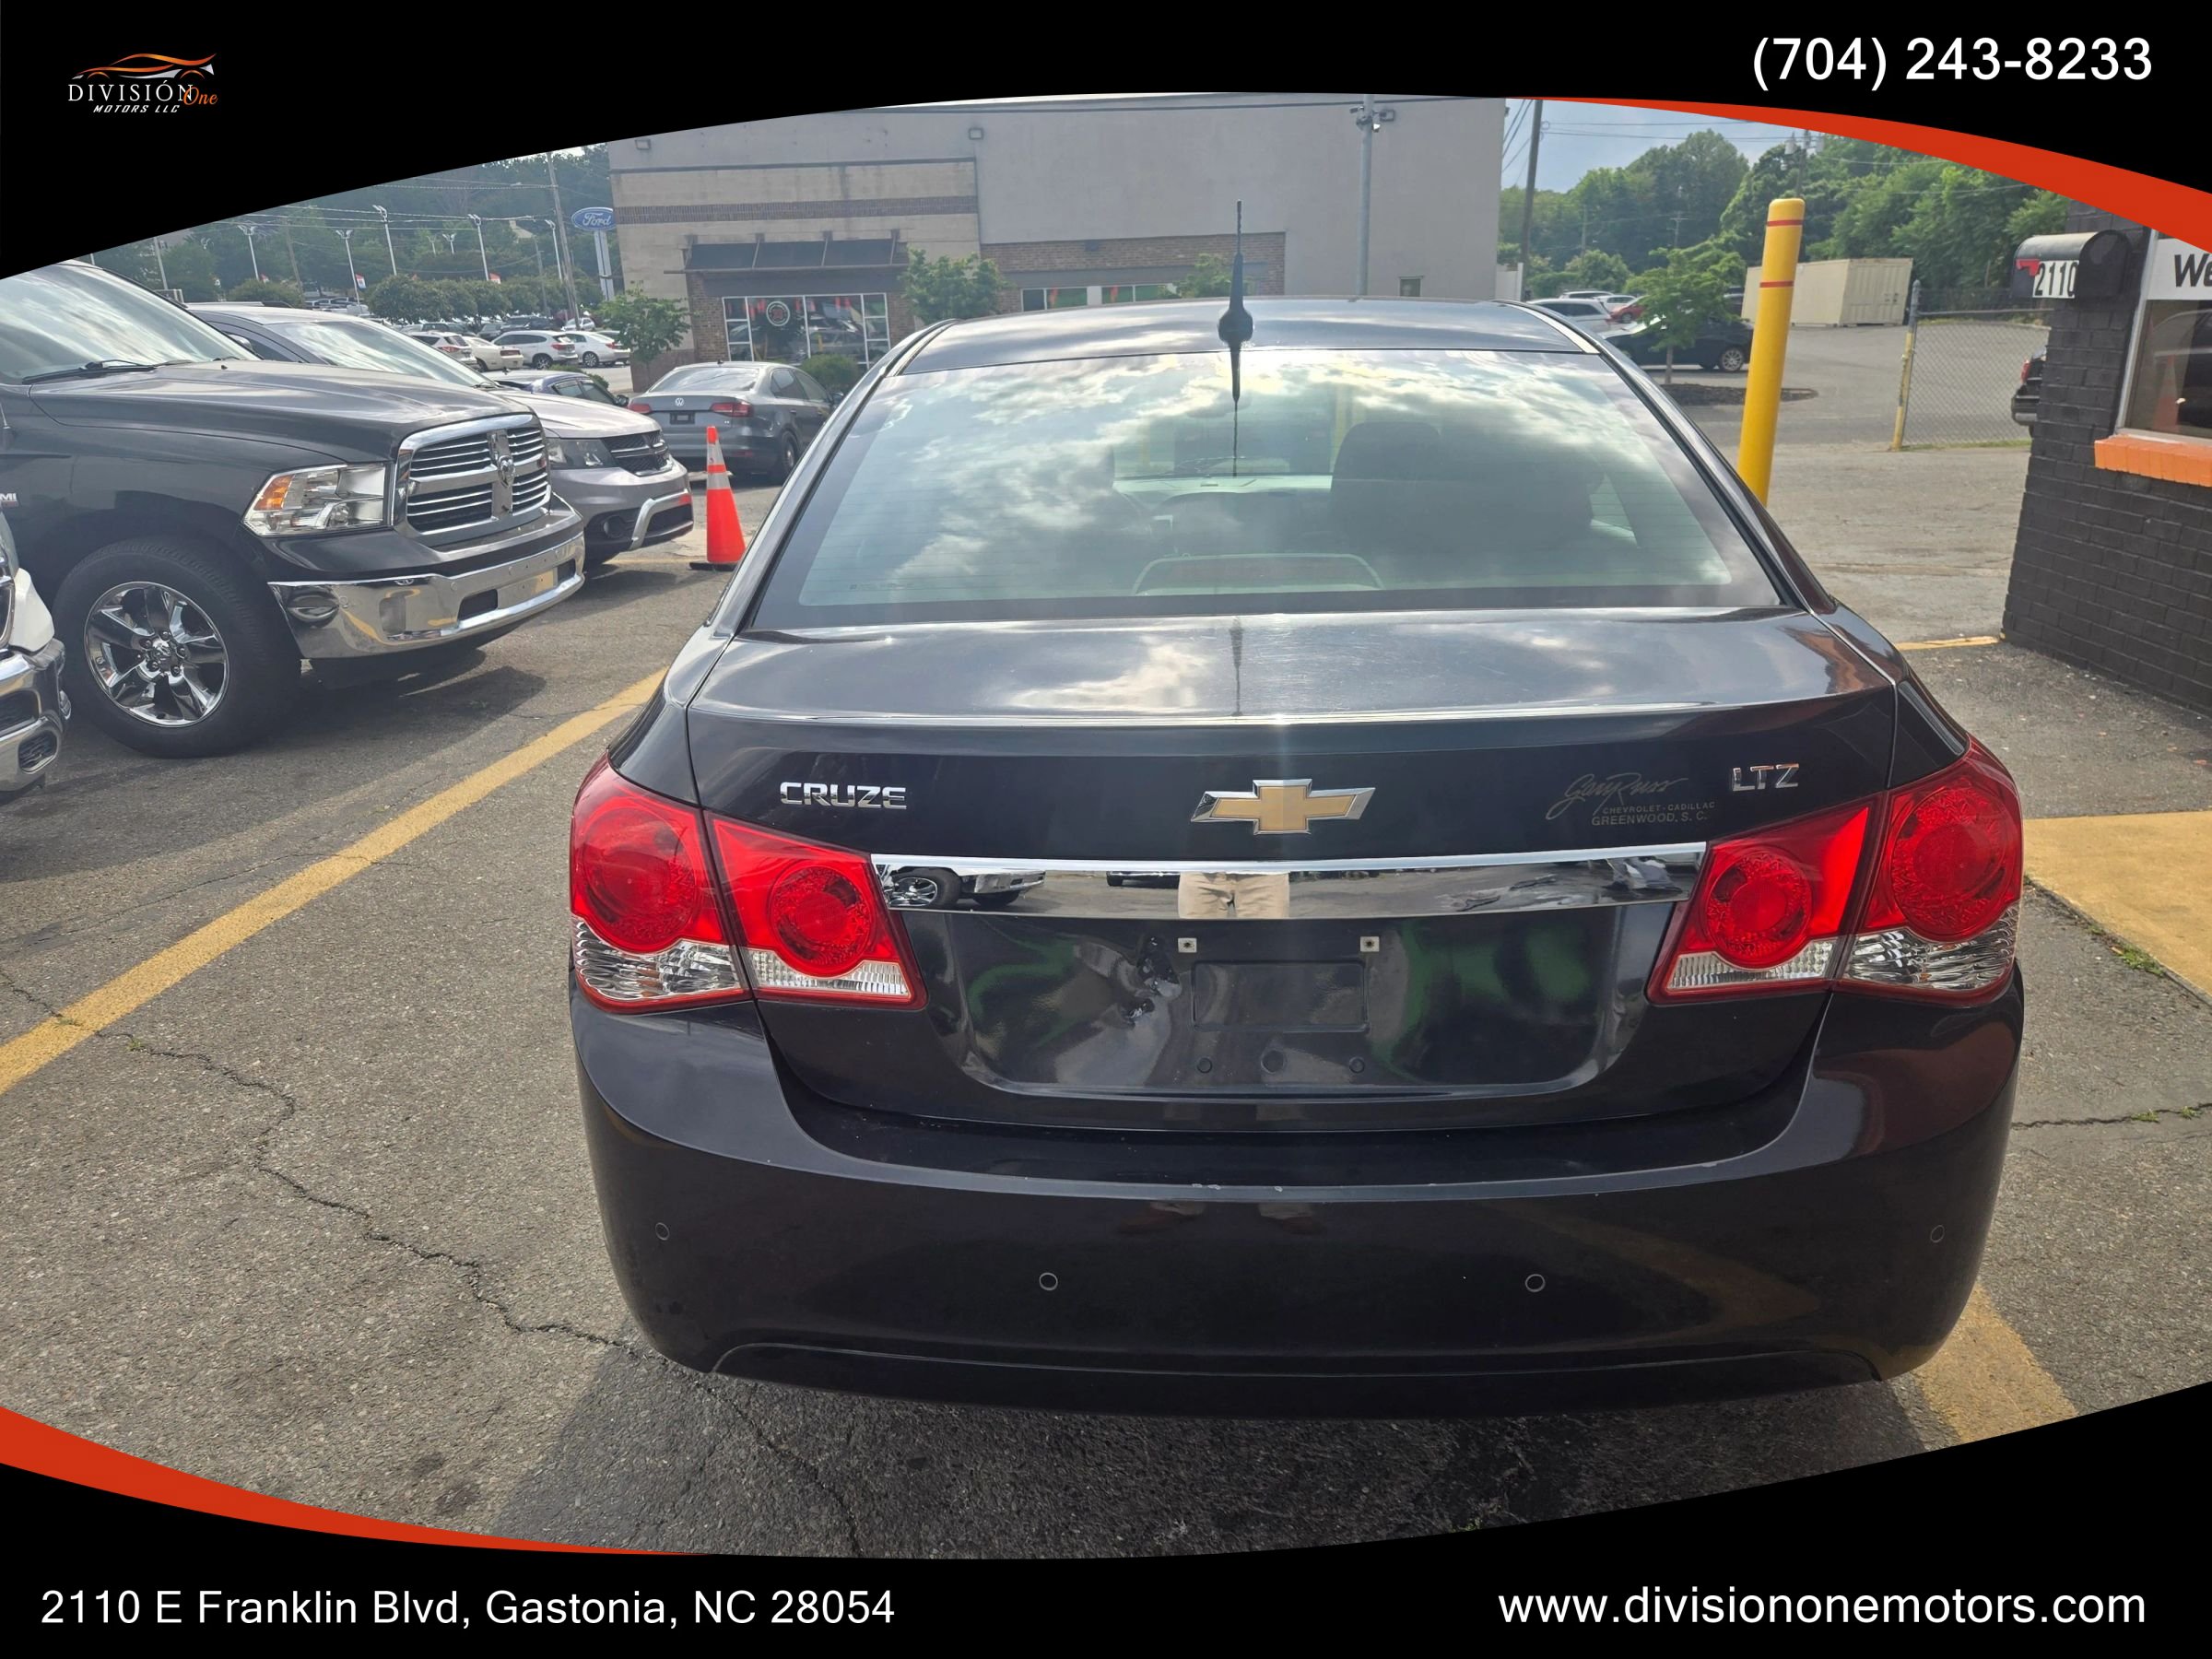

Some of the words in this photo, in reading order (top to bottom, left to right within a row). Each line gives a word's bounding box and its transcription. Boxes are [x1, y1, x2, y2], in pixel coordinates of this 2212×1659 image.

[582, 212, 612, 226] Ford
[2035, 261, 2078, 298] 2110
[1732, 763, 1799, 792] LTZ
[780, 782, 908, 810] CRUZE
